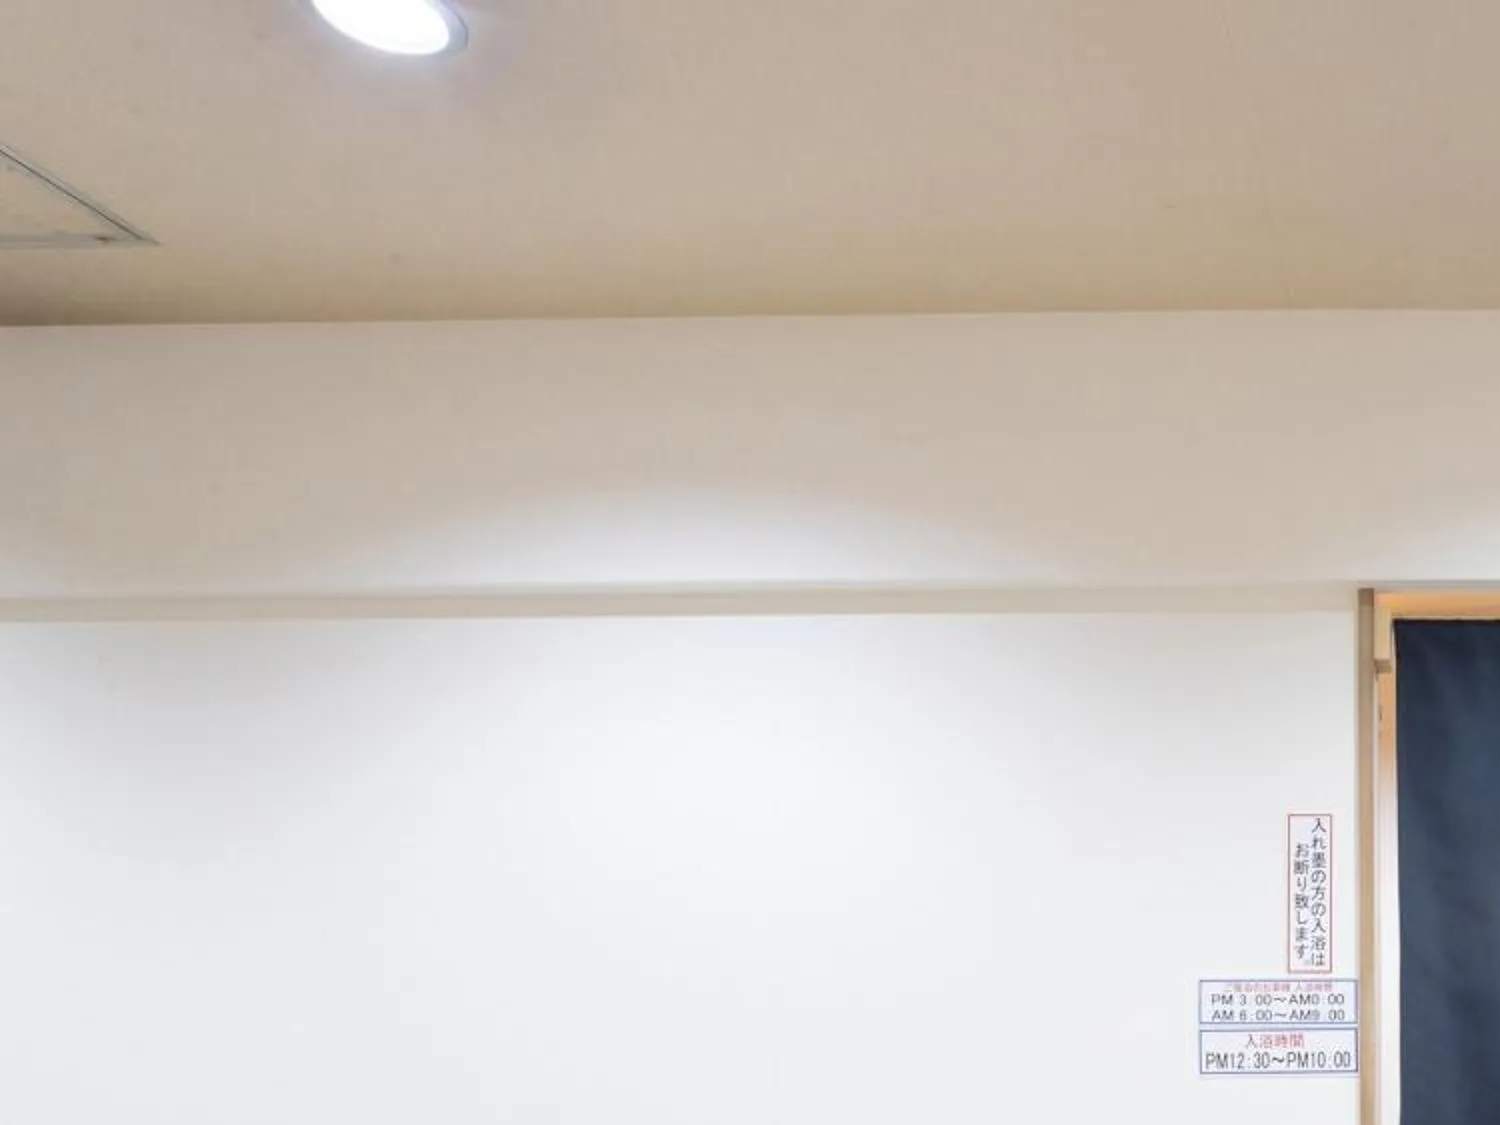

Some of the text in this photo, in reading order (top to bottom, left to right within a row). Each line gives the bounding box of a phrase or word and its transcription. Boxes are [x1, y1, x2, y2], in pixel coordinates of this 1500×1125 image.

[1311, 817, 1327, 967] 入れ墨の方の入浴は
[1211, 993, 1233, 1005] PM
[1211, 1008, 1233, 1021] AM
[1246, 1033, 1305, 1049] 入浴時間
